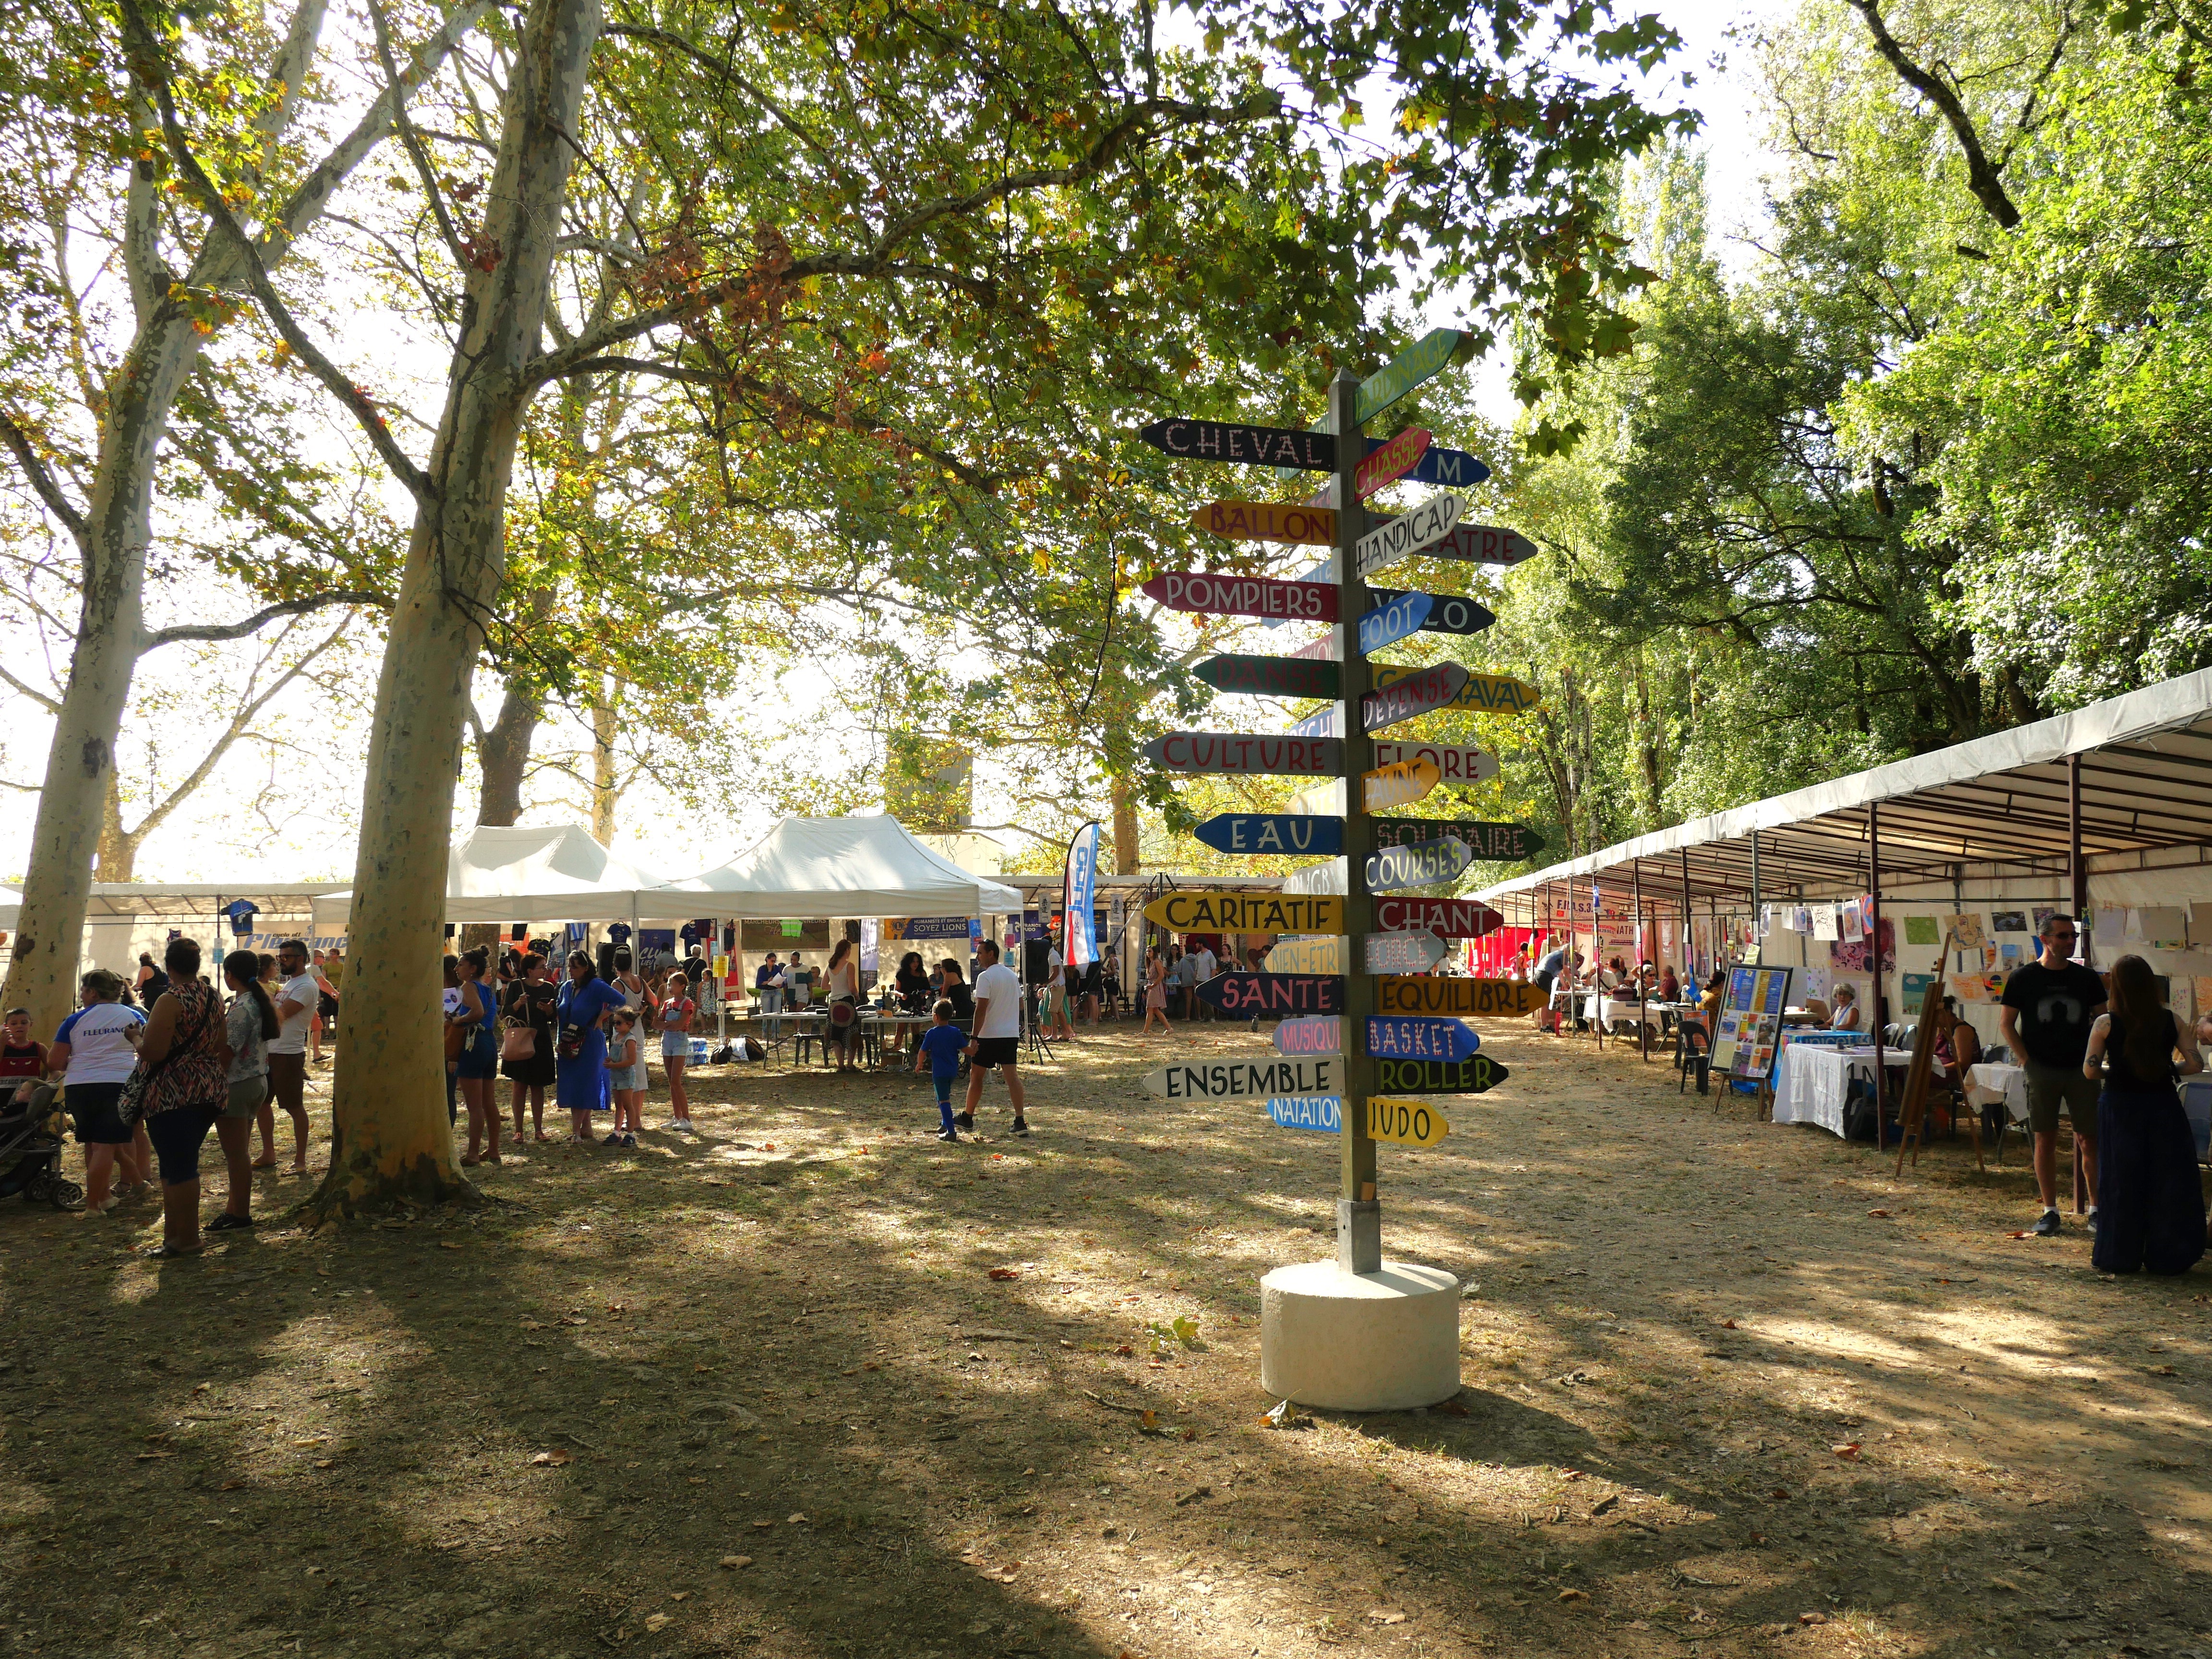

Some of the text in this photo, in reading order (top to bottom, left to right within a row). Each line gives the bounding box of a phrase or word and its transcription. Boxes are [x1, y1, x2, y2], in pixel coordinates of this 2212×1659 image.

[1355, 329, 1446, 411] JARDINAGE
[1165, 423, 1322, 465] CHEVAL
[1354, 429, 1419, 494] CHASSE
[1210, 504, 1331, 542] BALLON
[1357, 495, 1454, 573] HANDICAP
[1166, 576, 1322, 616] POMPIERS
[1359, 597, 1414, 650] FOOT
[1215, 657, 1324, 695] DANSE
[1163, 736, 1325, 770] CULTURE
[1363, 762, 1422, 807] FAUNE
[1231, 819, 1313, 850] EAU
[1365, 842, 1462, 887] COURSES
[914, 924, 940, 932] SOYEZ
[942, 923, 966, 931] LIONS
[1166, 894, 1332, 929] CARITATIF
[1379, 902, 1489, 935] CHANT
[639, 947, 662, 960] CLU
[1272, 940, 1336, 974] BIEN-ÊTR
[1366, 934, 1429, 969] FORCE
[1222, 974, 1333, 1010] SANTÉ
[1382, 975, 1530, 1012] ÉQUILIBRE
[83, 1027, 125, 1036] FLEURANC
[1370, 1021, 1456, 1058] BASKET
[1166, 1061, 1331, 1098] ENSEMBLE
[1380, 1060, 1492, 1091] ROLLER
[1274, 1097, 1341, 1129] NATATION
[1371, 1105, 1430, 1141] JUDO
